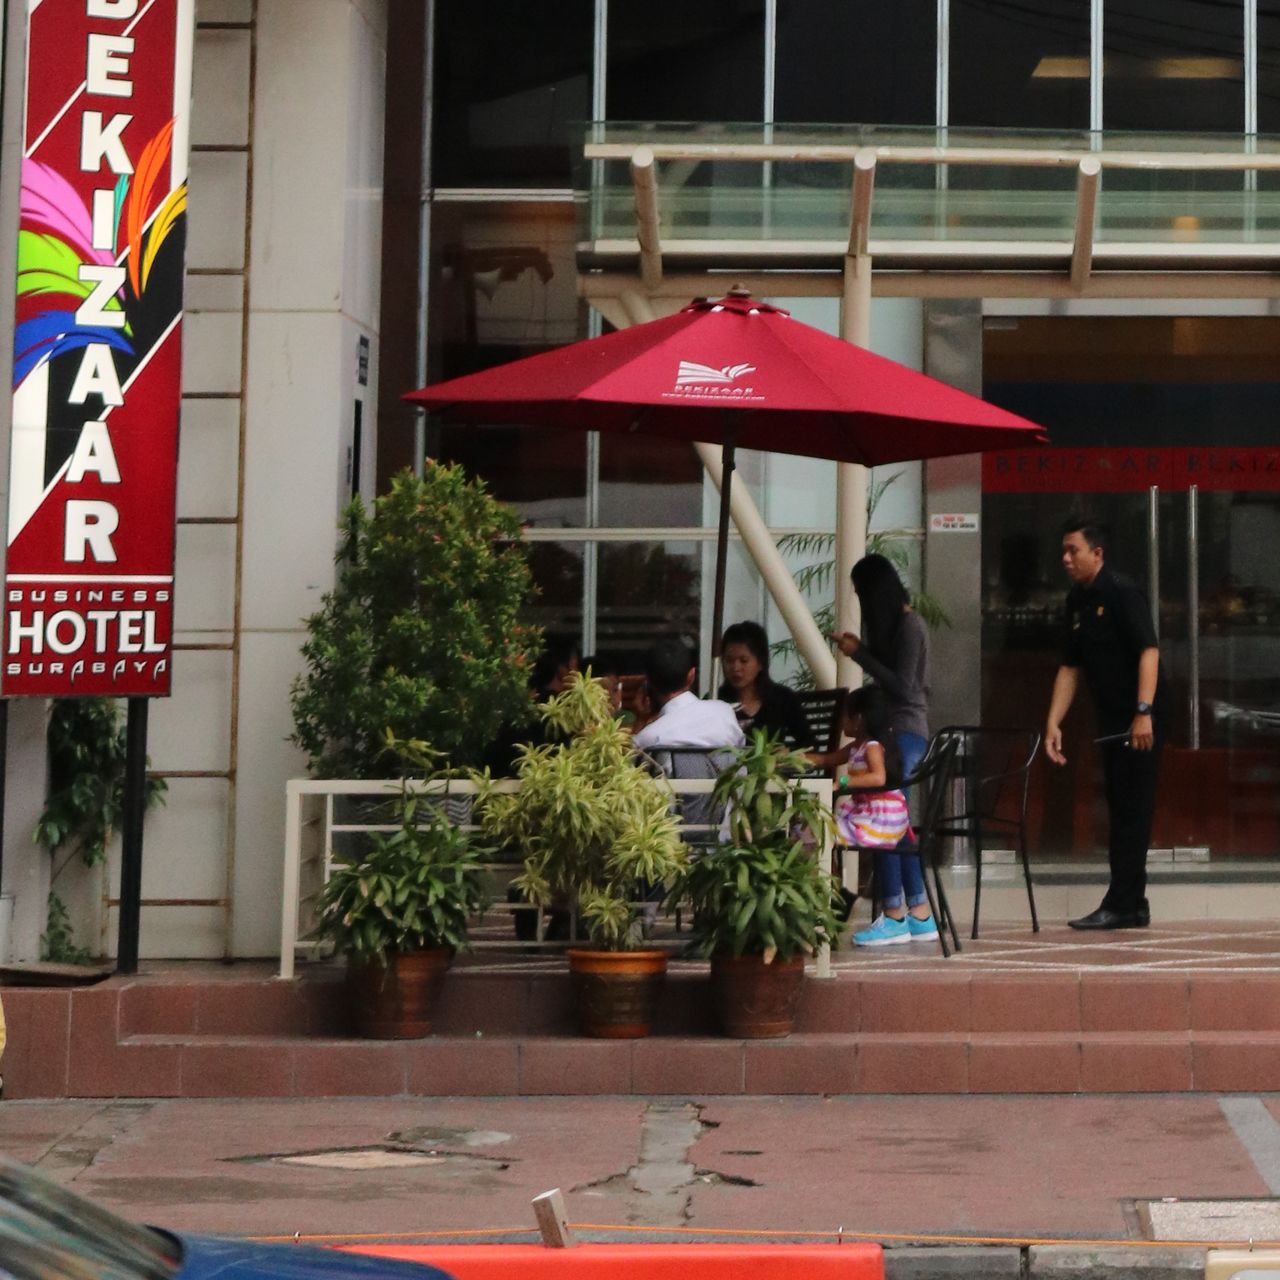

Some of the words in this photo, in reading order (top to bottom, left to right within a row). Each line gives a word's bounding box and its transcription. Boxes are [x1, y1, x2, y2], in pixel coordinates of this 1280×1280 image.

[8, 590, 170, 603] BUSINESS
[8, 609, 168, 655] HOTEL
[7, 658, 167, 684] SURABAYA
